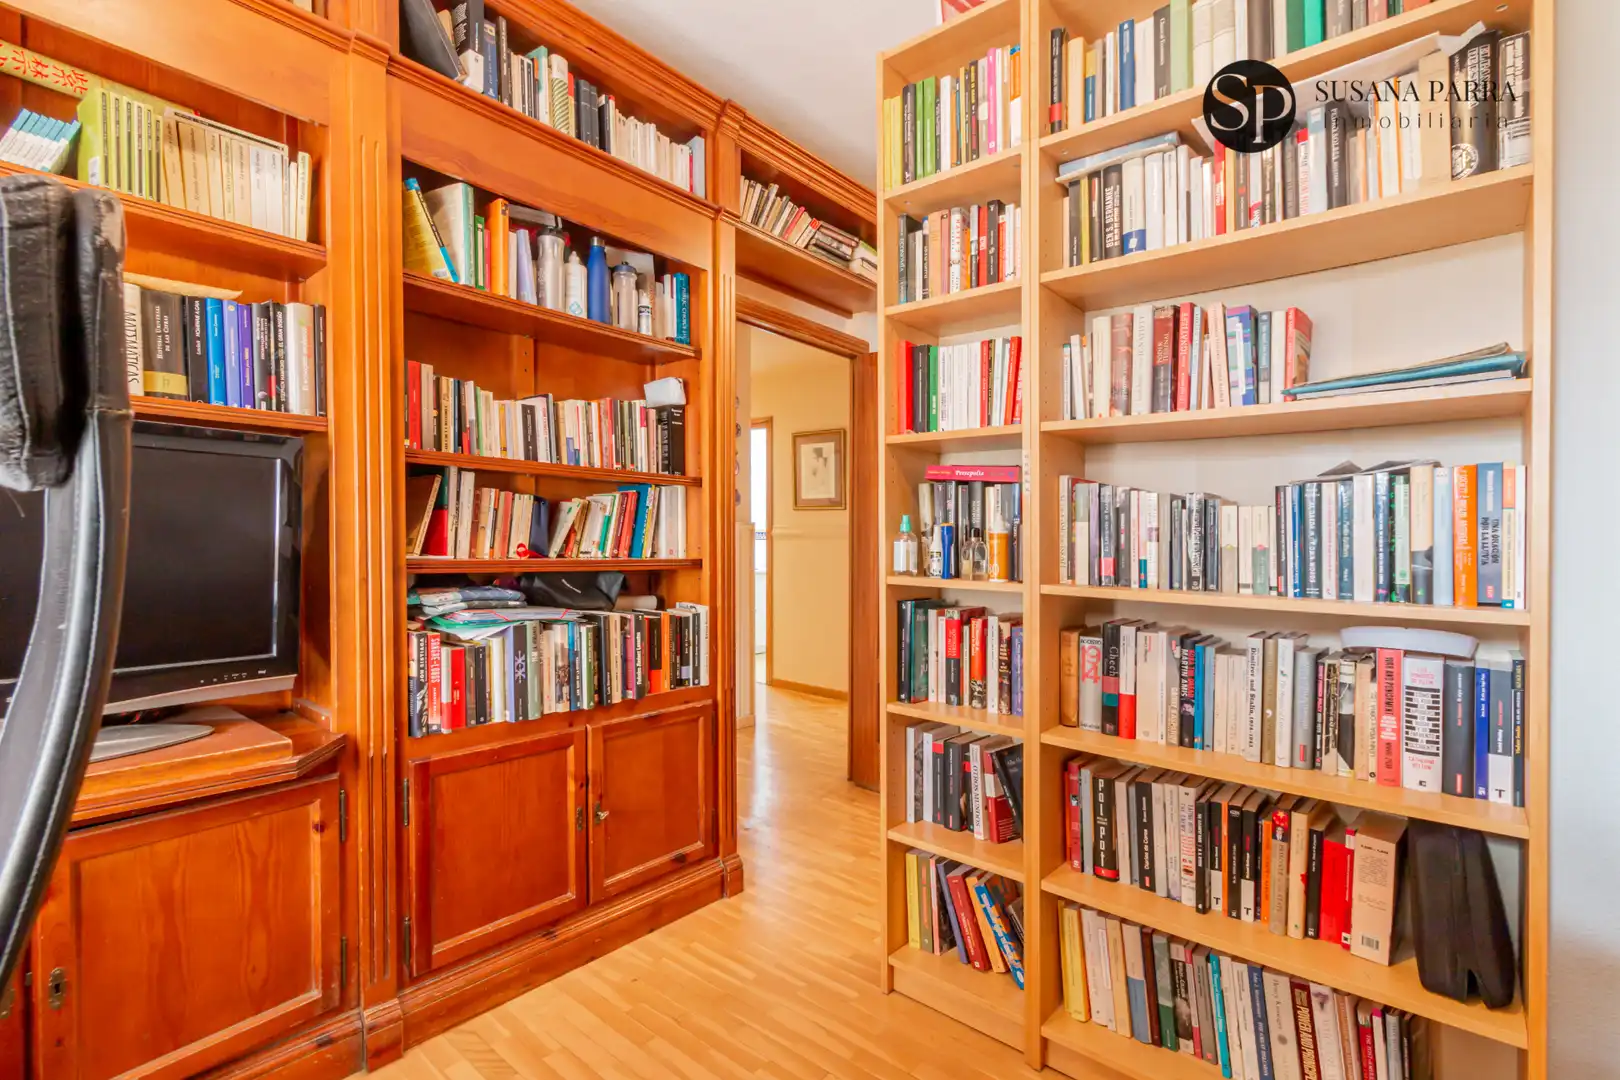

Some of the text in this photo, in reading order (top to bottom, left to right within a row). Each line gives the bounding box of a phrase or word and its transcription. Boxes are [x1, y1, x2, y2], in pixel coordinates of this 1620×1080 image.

[1105, 186, 1114, 248] BEN S. BERNANKE
[955, 470, 985, 478] Persepolis
[1296, 1005, 1312, 1032] POWER
[1300, 1031, 1314, 1048] AND
